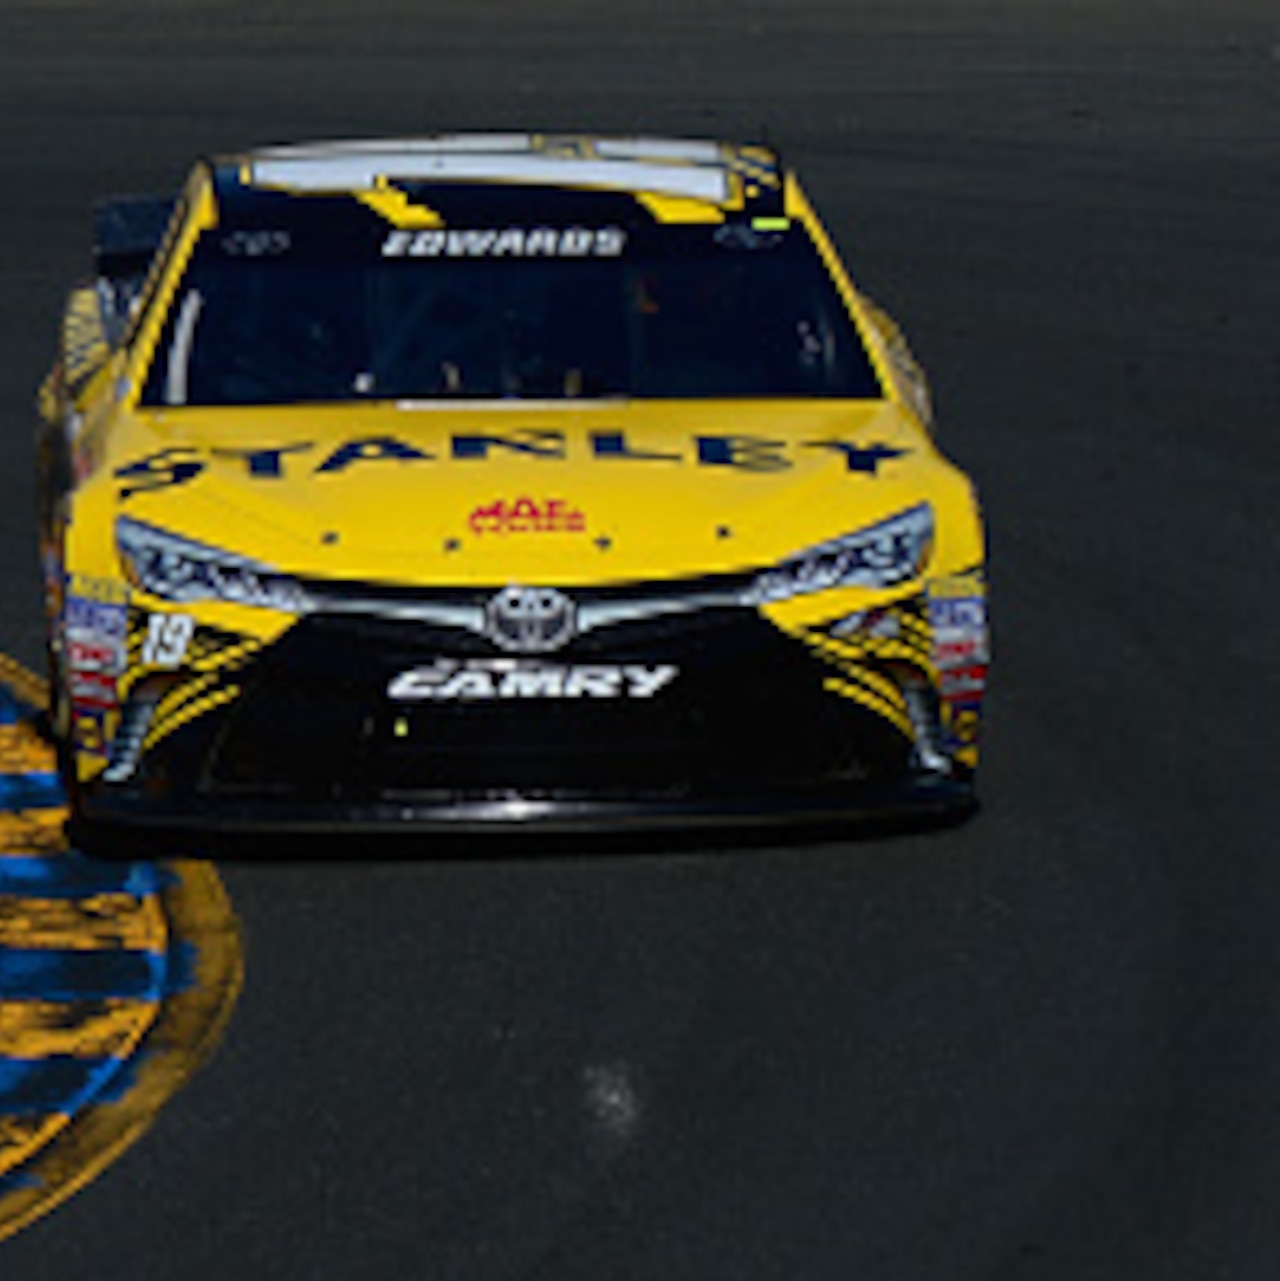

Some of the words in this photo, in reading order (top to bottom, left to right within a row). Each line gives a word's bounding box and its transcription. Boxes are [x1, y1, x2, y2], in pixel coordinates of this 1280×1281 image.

[381, 229, 627, 257] EDWARDS
[113, 431, 914, 501] STANLEY
[142, 613, 194, 668] 19
[388, 662, 680, 698] CAMRY
